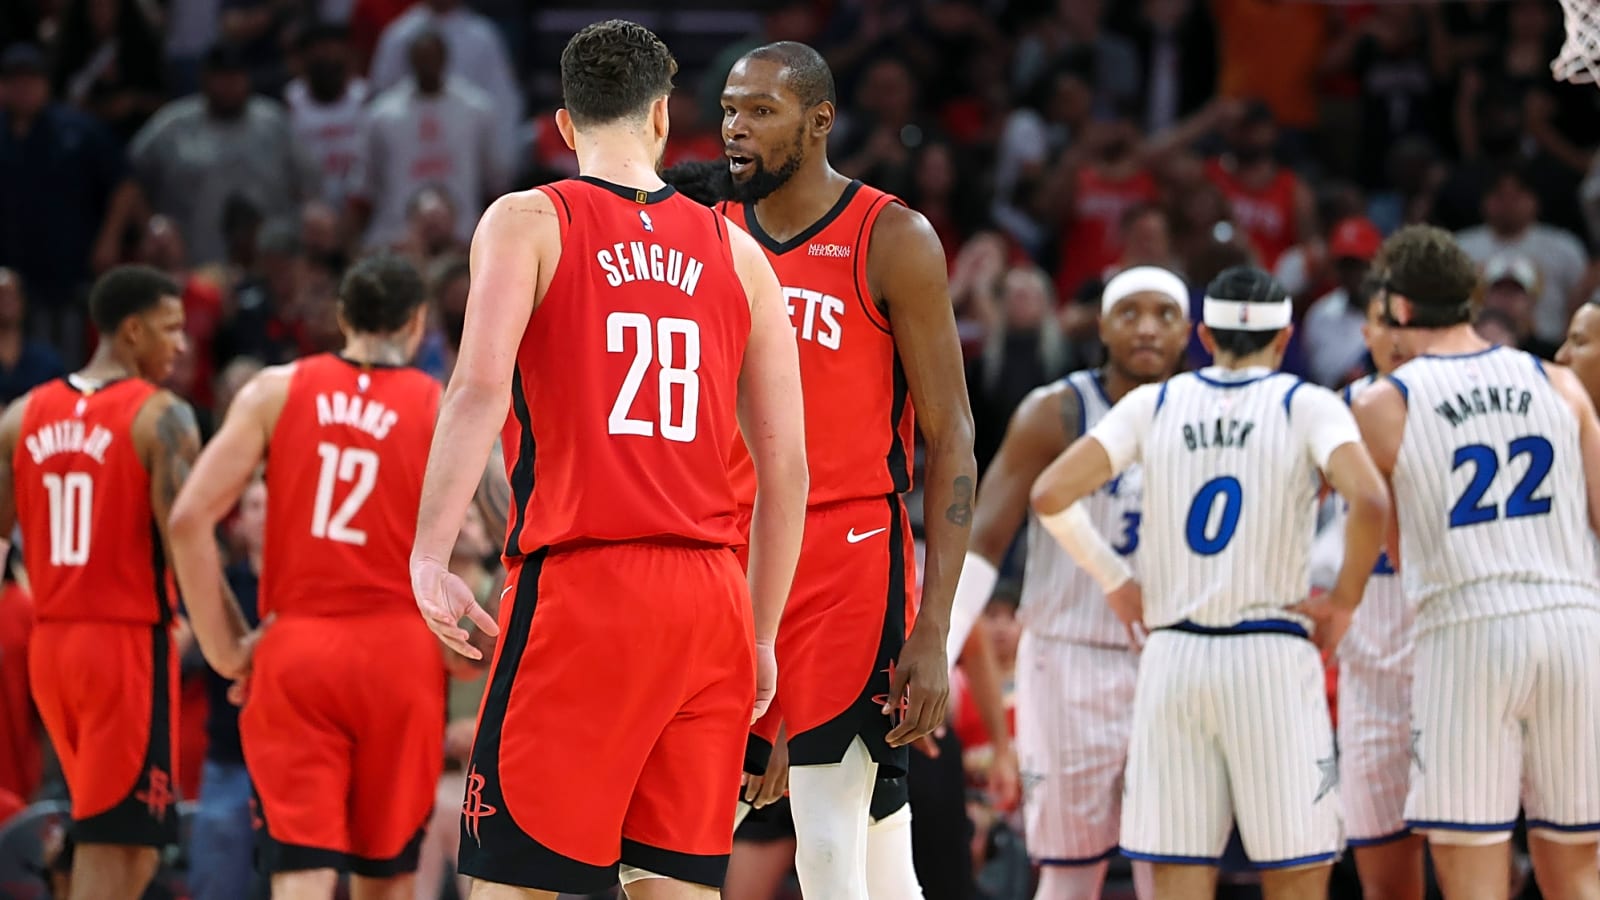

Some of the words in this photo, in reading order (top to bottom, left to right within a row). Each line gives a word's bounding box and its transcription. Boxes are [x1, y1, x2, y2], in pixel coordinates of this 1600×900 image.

[597, 241, 704, 297] SENGUN
[807, 249, 850, 258] HERMANN
[809, 243, 850, 252] MEMORIAL
[606, 311, 701, 443] 28
[316, 391, 398, 440] ADAMS
[1435, 387, 1532, 429] WAGNER
[25, 419, 85, 465] SMITH
[1182, 418, 1254, 452] BLACK
[311, 441, 380, 546] 12
[1448, 434, 1555, 528] 22
[42, 472, 93, 566] 10
[1185, 475, 1243, 556] 0
